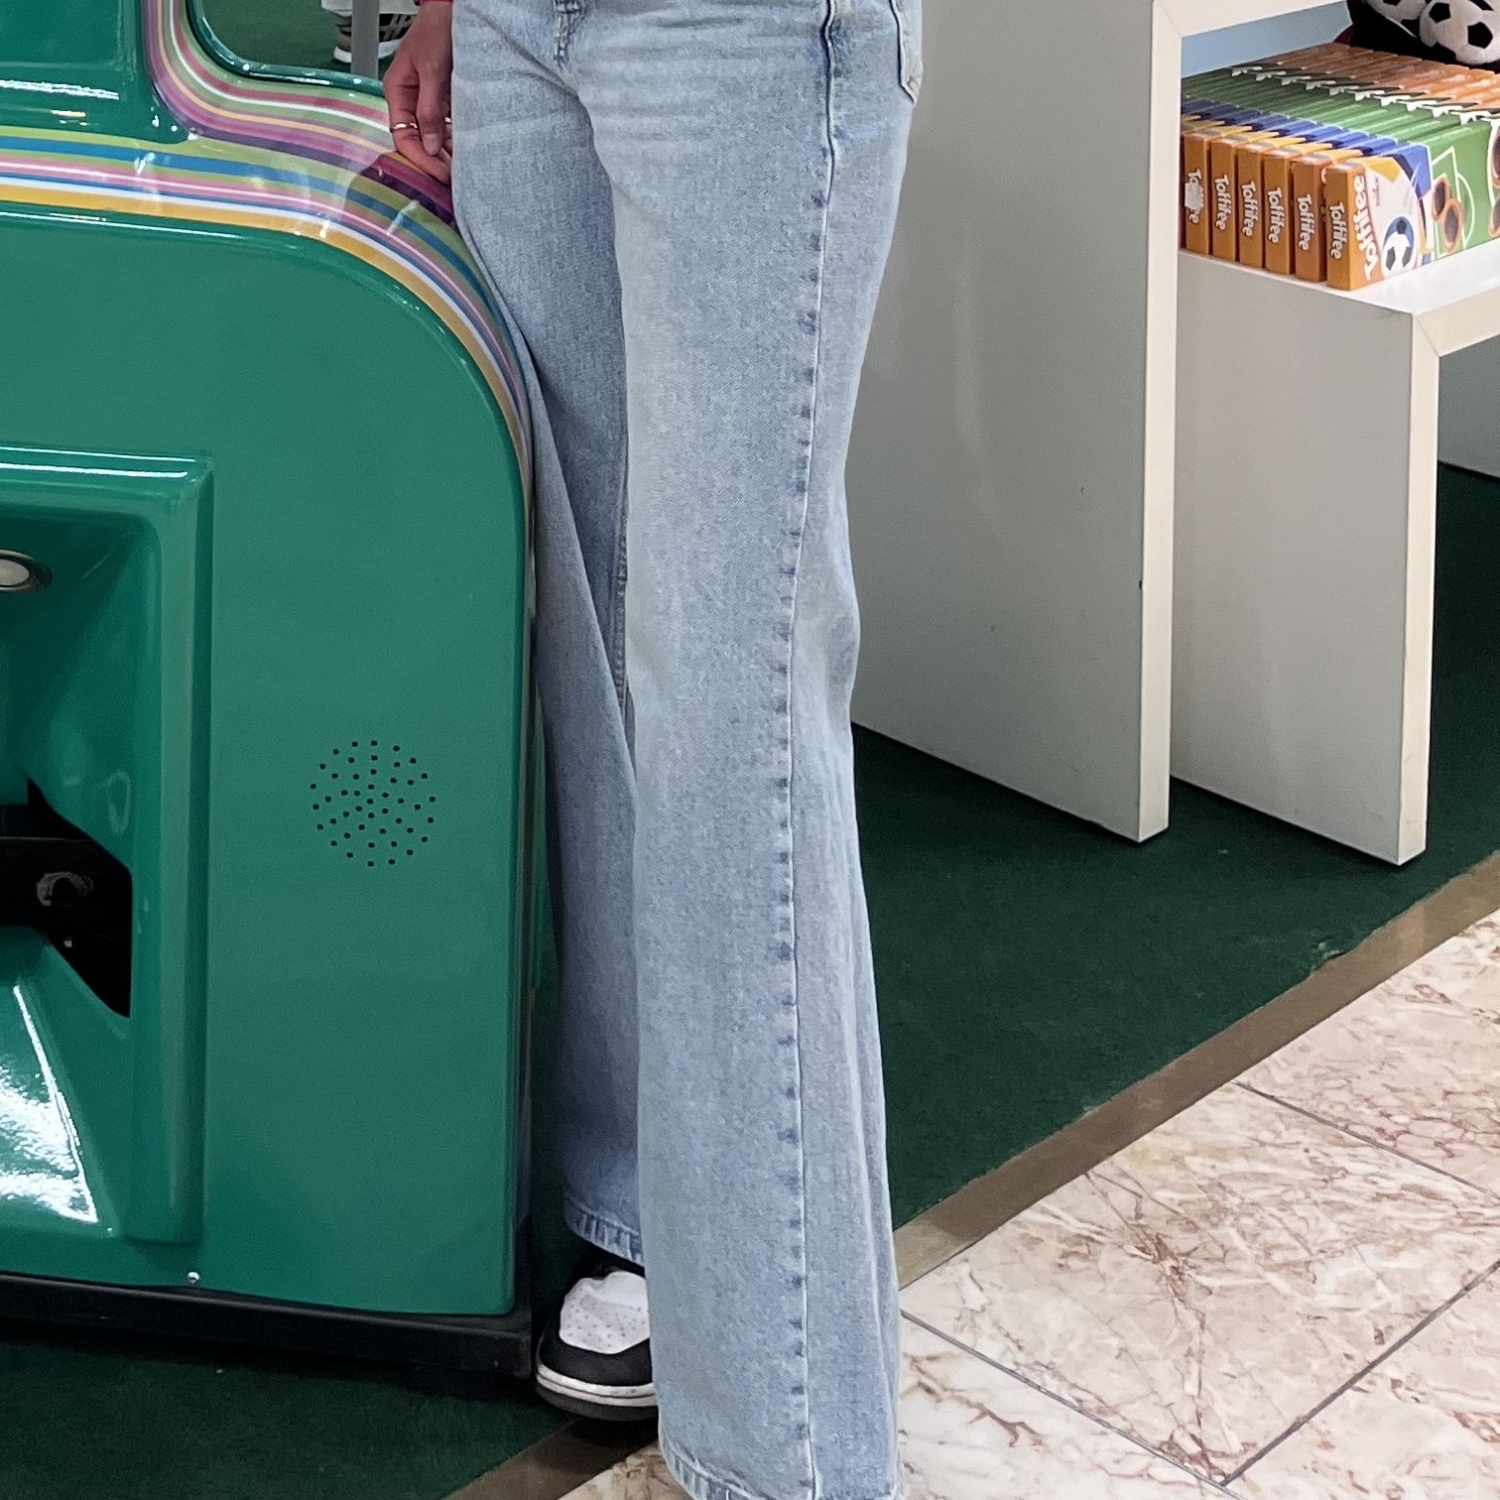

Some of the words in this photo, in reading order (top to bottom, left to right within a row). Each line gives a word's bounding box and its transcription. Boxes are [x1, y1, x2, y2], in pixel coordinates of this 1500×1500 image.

[1214, 174, 1232, 230] Toffifee
[1241, 180, 1259, 237] Toffifee
[1267, 187, 1285, 243] Toffifee
[1297, 193, 1315, 251] Toffifee
[1330, 202, 1348, 259] Toffifee
[1352, 175, 1379, 281] Toffifee
